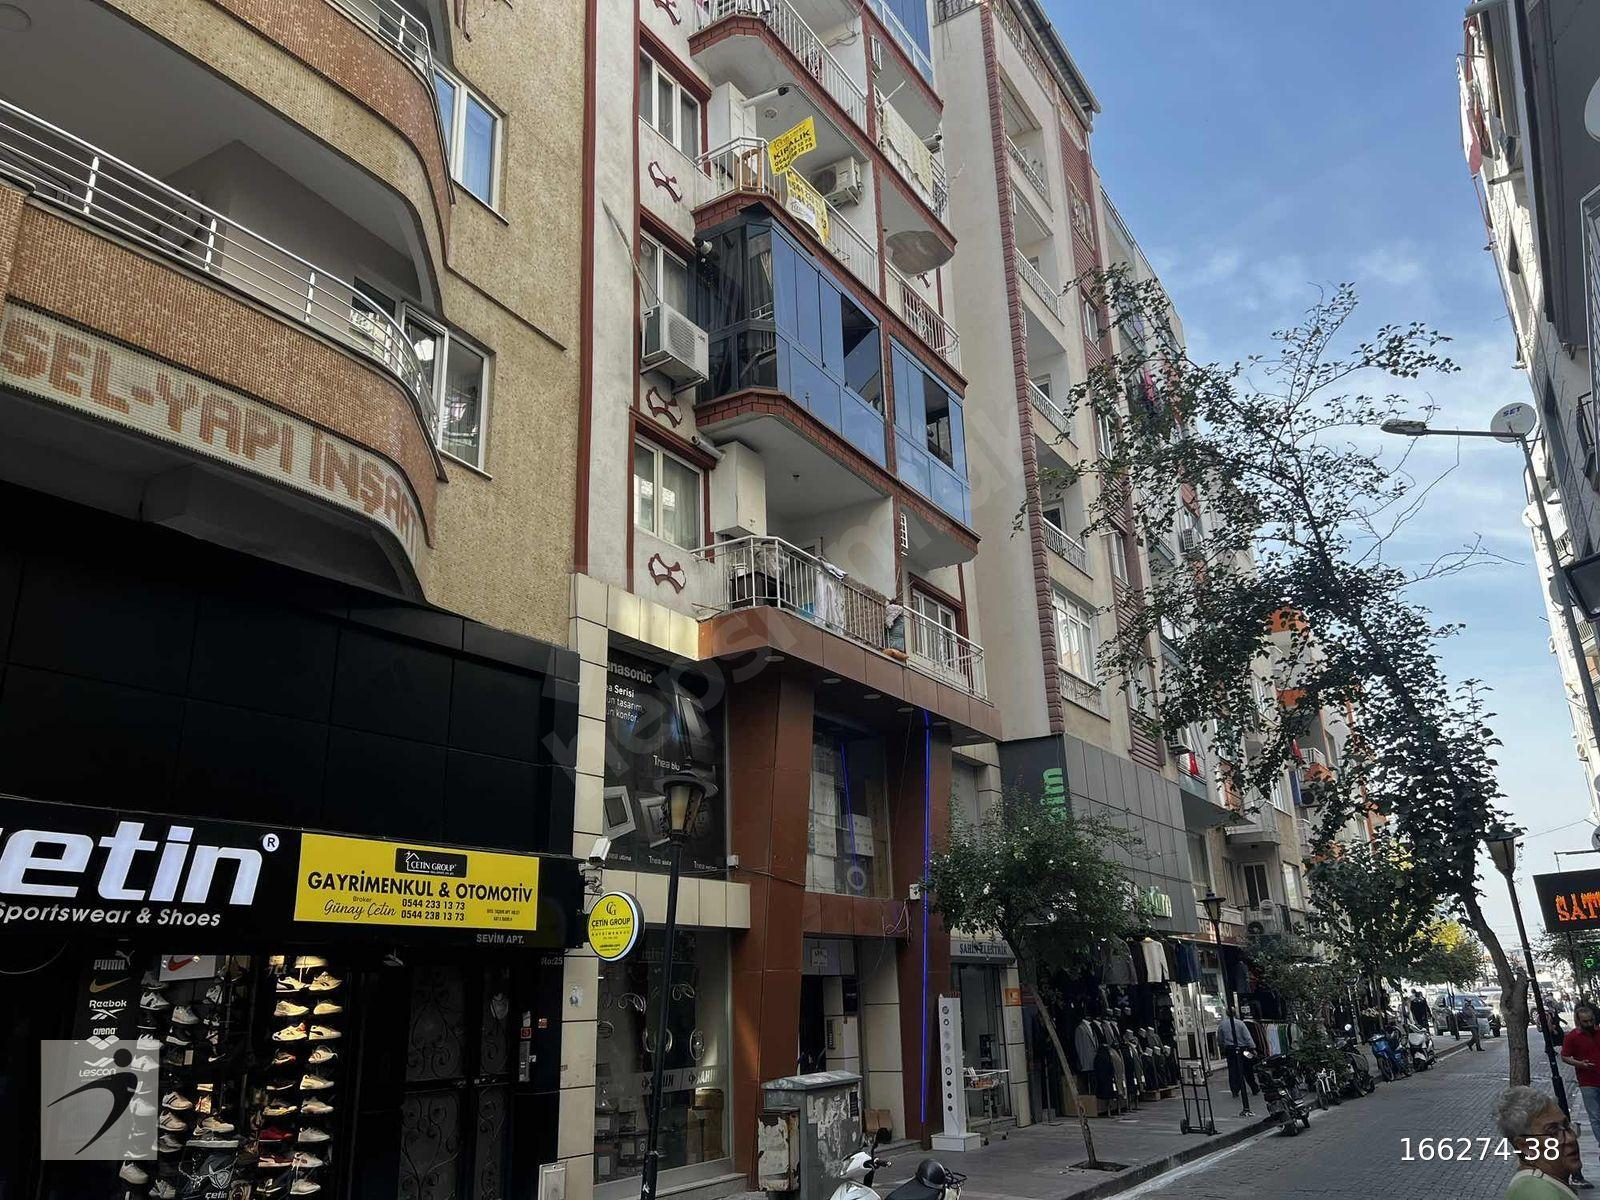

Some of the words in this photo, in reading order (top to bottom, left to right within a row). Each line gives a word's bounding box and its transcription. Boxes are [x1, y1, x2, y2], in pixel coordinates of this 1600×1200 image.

[0, 318, 293, 474] SEL-YAPI
[607, 661, 653, 684] anasonic
[614, 684, 635, 698] Serisi
[0, 820, 263, 906] etin
[307, 869, 434, 897] GAYRİMENKUL
[438, 882, 450, 898] &
[455, 882, 533, 903] OTOMOTİV
[324, 899, 364, 921] Günay
[401, 898, 423, 908] 0544
[425, 900, 441, 909] 233
[443, 901, 453, 910] 13
[455, 902, 466, 911] 73
[1555, 891, 1600, 922] SAT
[136, 908, 151, 924] &
[157, 908, 221, 926] Shoes
[401, 909, 422, 919] 0544
[424, 910, 440, 920] 238
[443, 912, 452, 921] 13
[455, 912, 465, 921] 73
[609, 917, 630, 926] GROUP
[506, 935, 525, 944] APT.
[94, 960, 126, 971] PUMA
[89, 1000, 127, 1009] Reebok
[93, 1027, 116, 1036] arena
